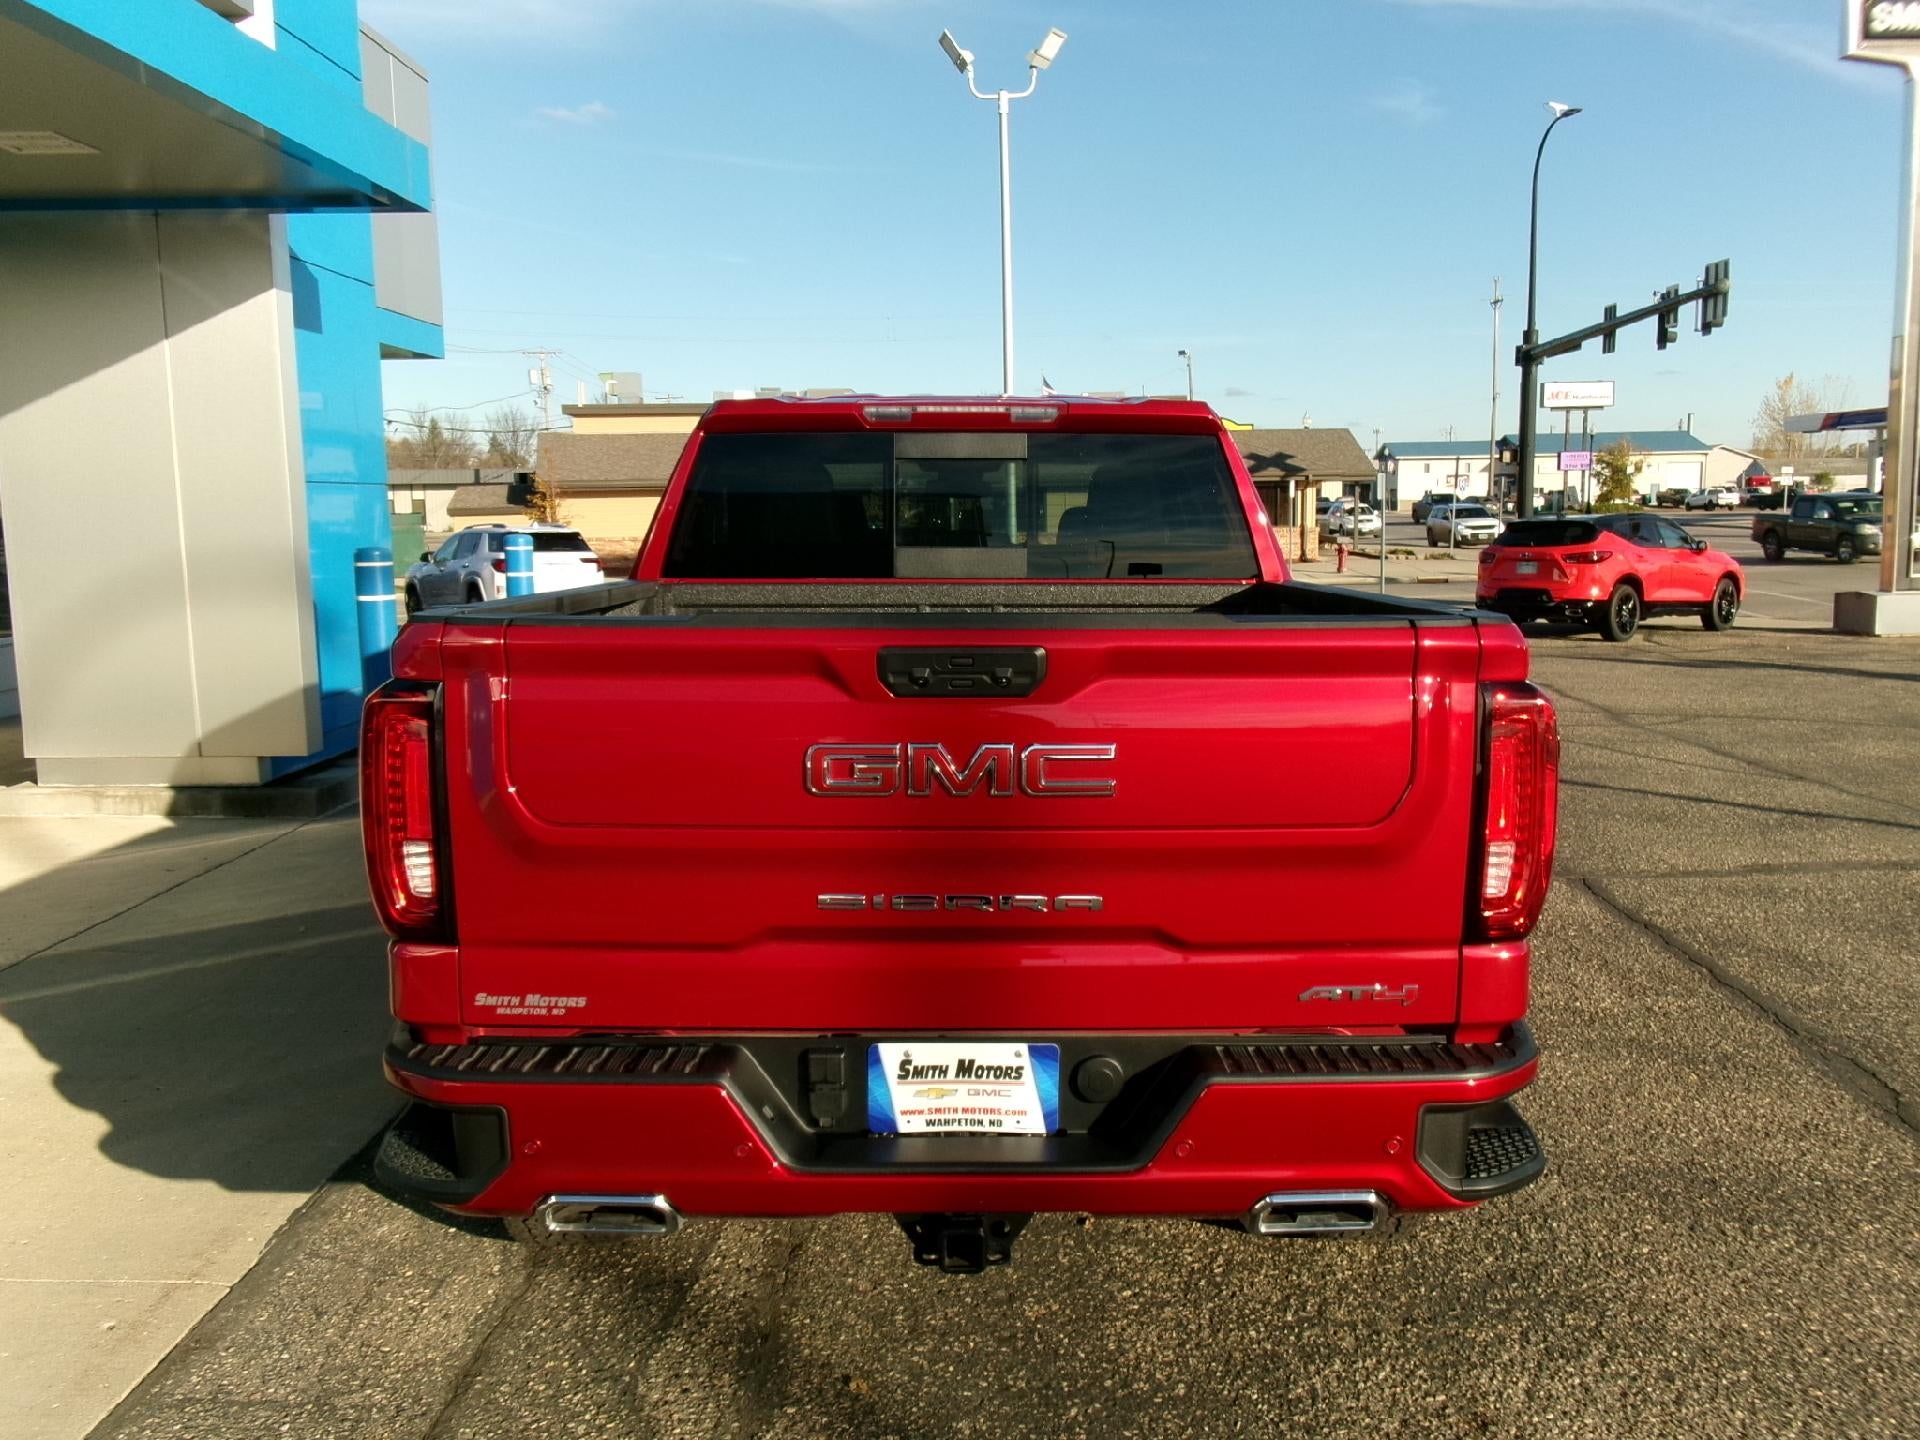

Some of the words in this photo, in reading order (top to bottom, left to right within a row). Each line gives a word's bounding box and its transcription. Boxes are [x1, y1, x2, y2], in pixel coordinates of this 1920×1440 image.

[804, 742, 1118, 797] GMC
[816, 893, 1104, 912] SIERRA
[474, 992, 521, 1007] SMITH
[523, 993, 588, 1008] MOTORS
[1298, 982, 1419, 1007] AT4
[551, 1008, 566, 1016] ND
[896, 1058, 950, 1080] SMITH
[954, 1058, 1025, 1080] MOTORS
[967, 1087, 1012, 1097] GMC
[988, 1118, 1003, 1128] ND
